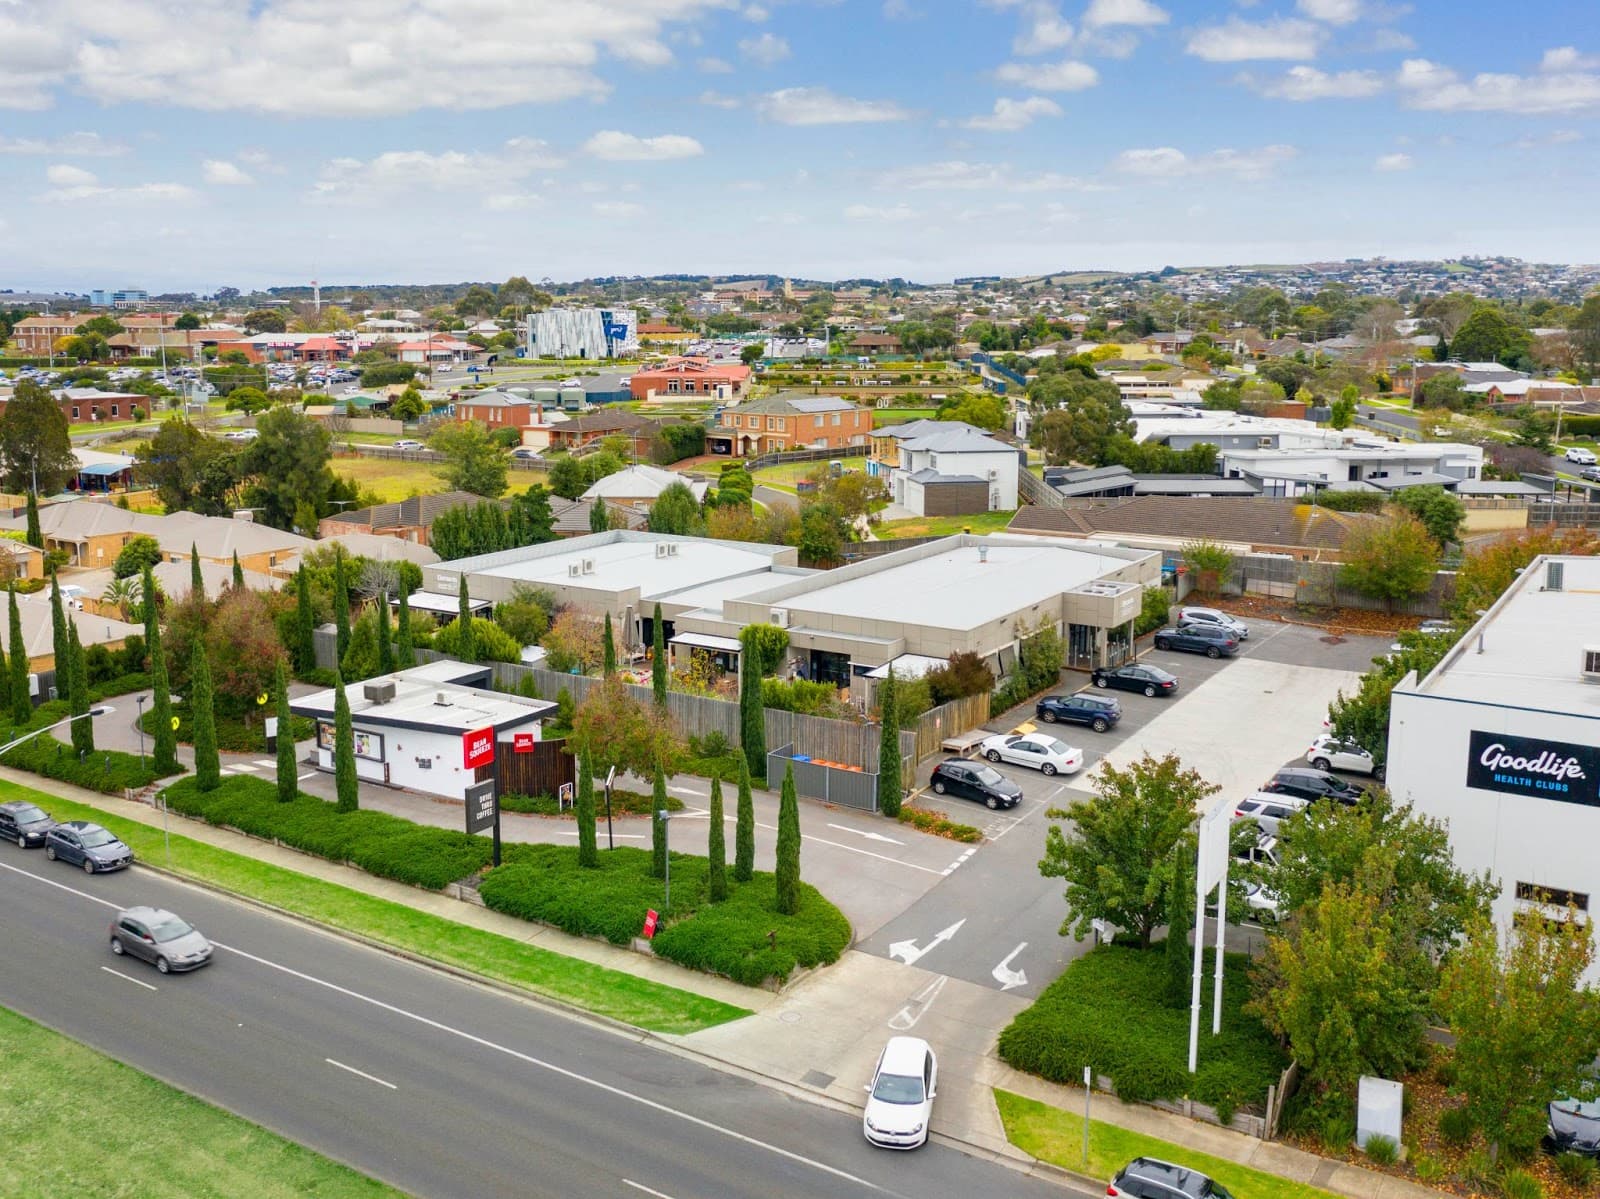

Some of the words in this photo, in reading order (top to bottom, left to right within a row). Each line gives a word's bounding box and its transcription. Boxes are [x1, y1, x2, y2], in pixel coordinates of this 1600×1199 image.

[473, 738, 486, 750] BEAN
[469, 743, 491, 759] SQUEEZE
[1494, 773, 1532, 787] HEALTH
[1535, 780, 1569, 793] CLUBS
[479, 793, 492, 803] DRIVE
[476, 809, 493, 820] COFFEE
